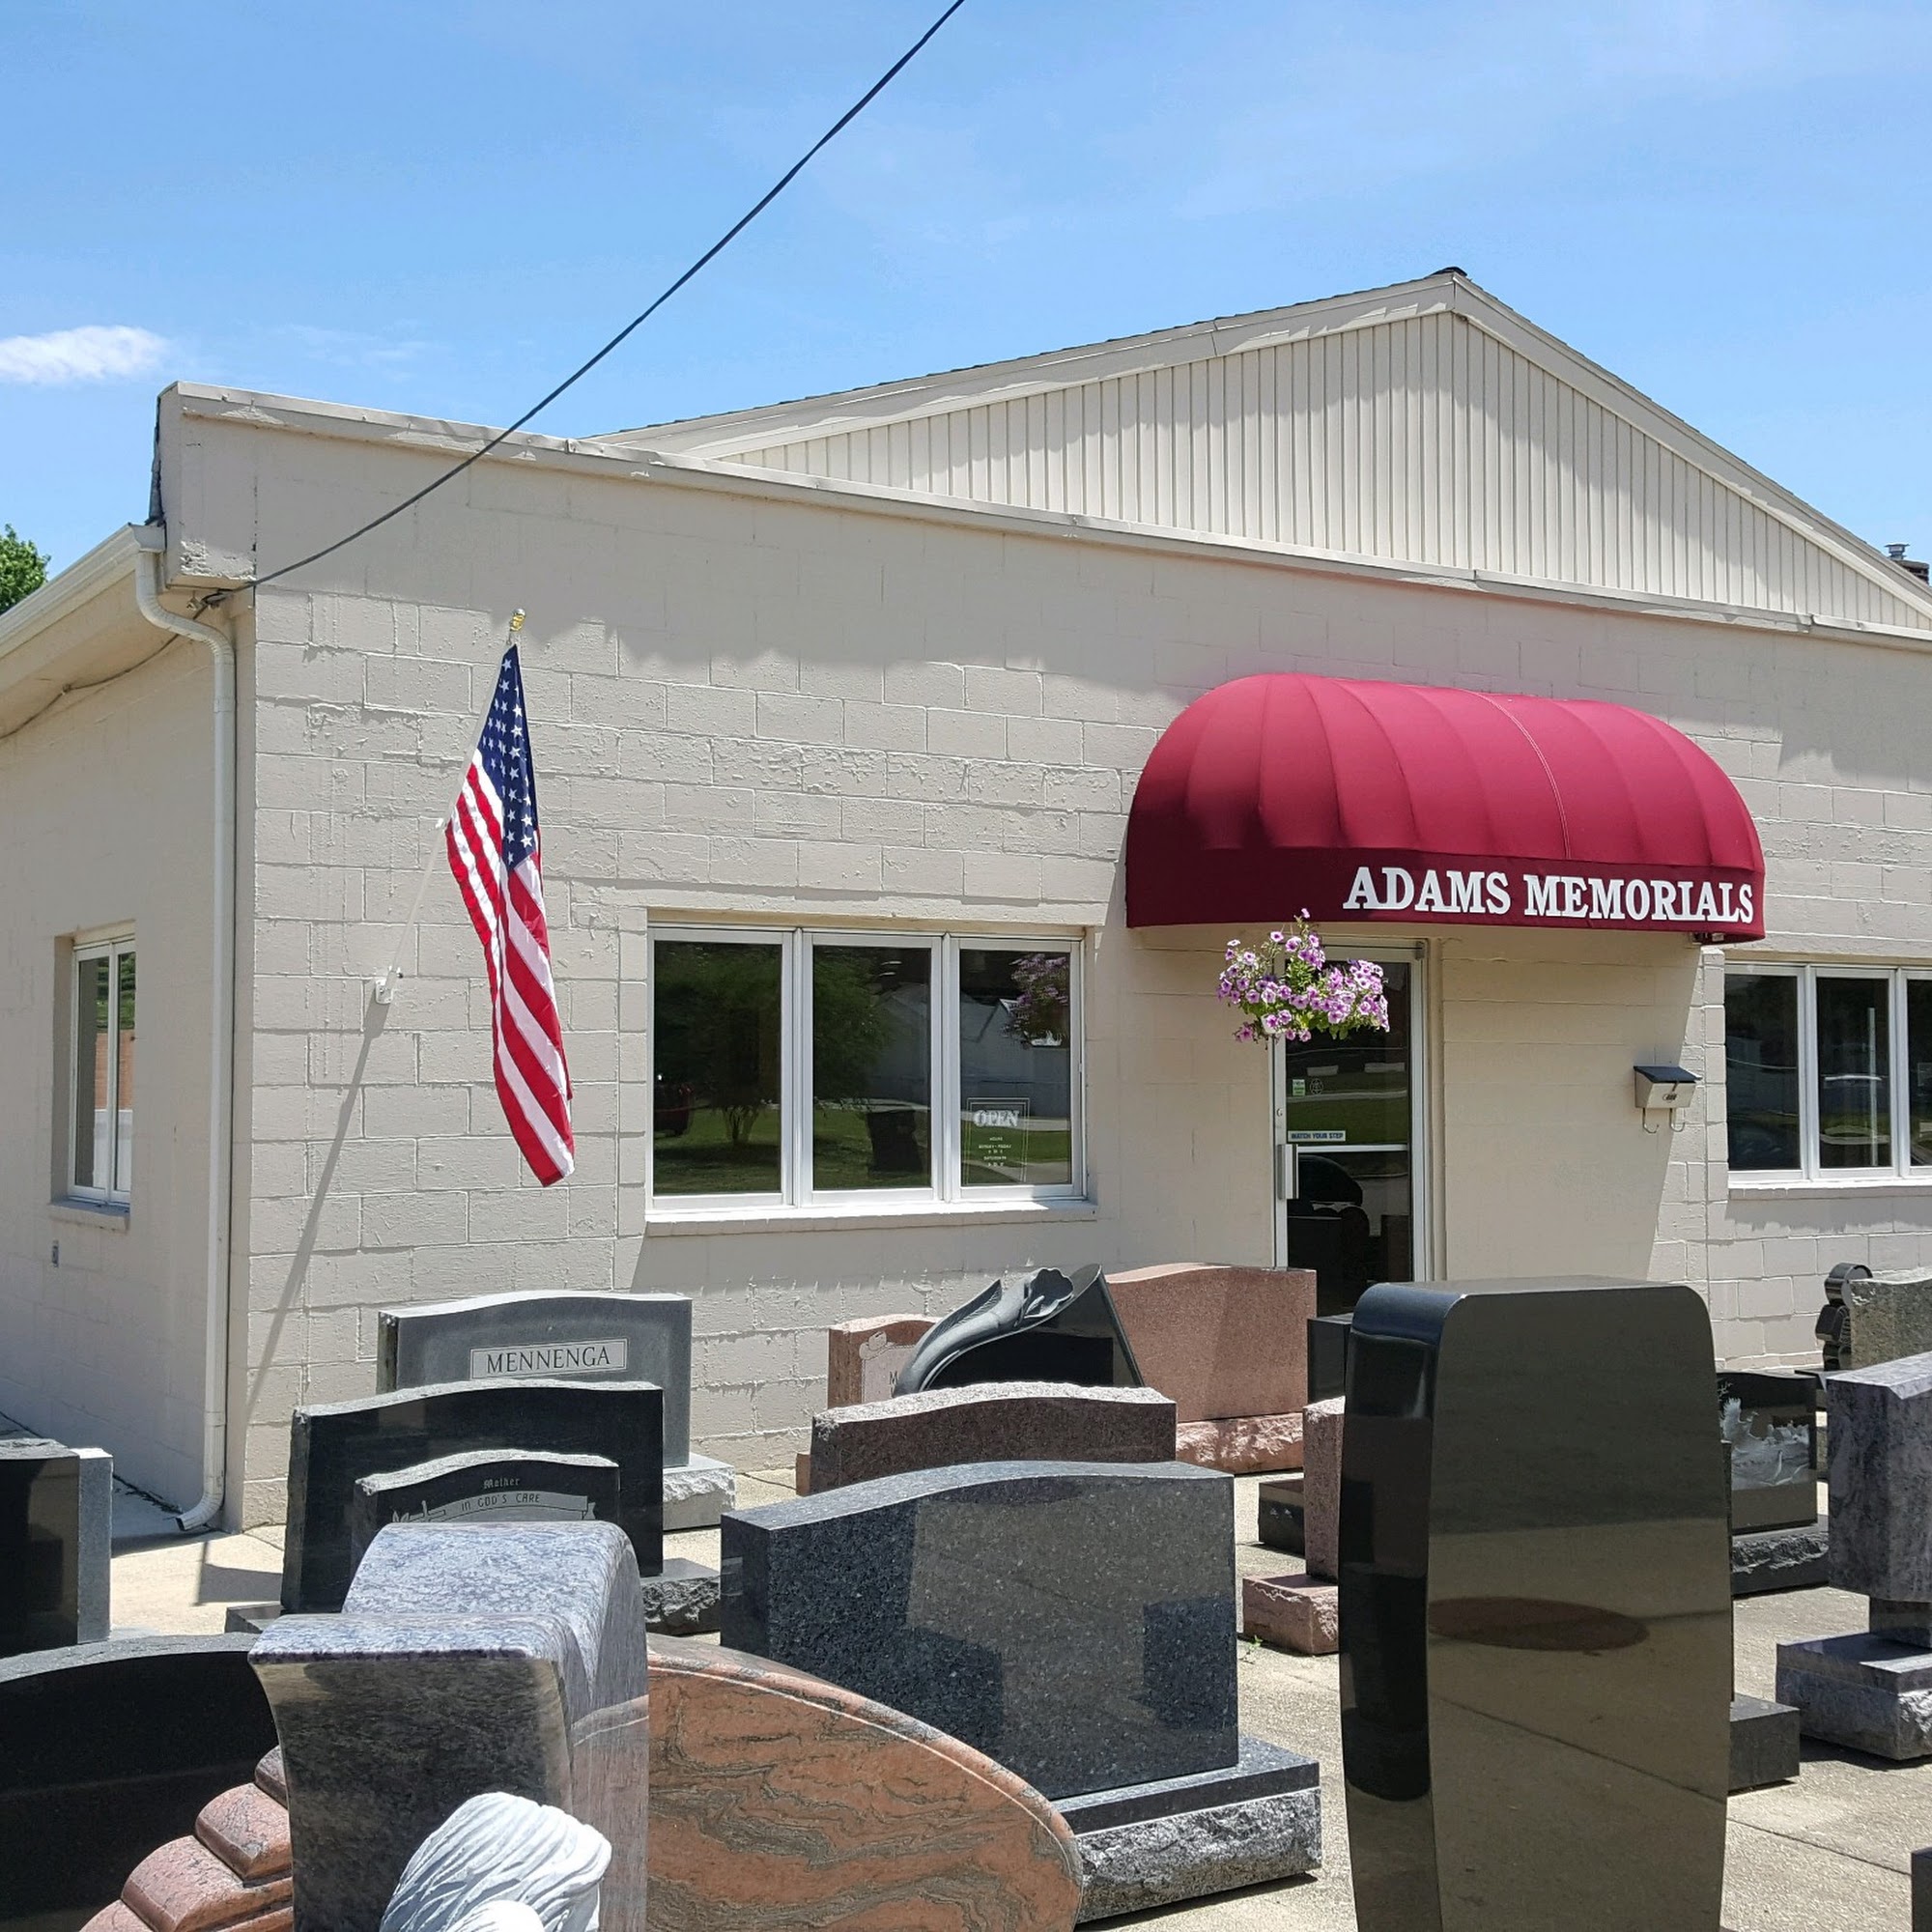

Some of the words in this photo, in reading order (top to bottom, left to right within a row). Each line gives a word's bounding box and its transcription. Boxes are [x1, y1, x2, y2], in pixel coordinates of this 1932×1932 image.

[1342, 867, 1512, 915] ADAMS
[1522, 873, 1754, 924] MEMORIALS
[974, 1109, 1020, 1127] OPEN
[487, 1346, 611, 1375] MENNENGA
[483, 1478, 521, 1490] Mother
[477, 1493, 507, 1507] GOD'S
[515, 1492, 541, 1504] CARE
